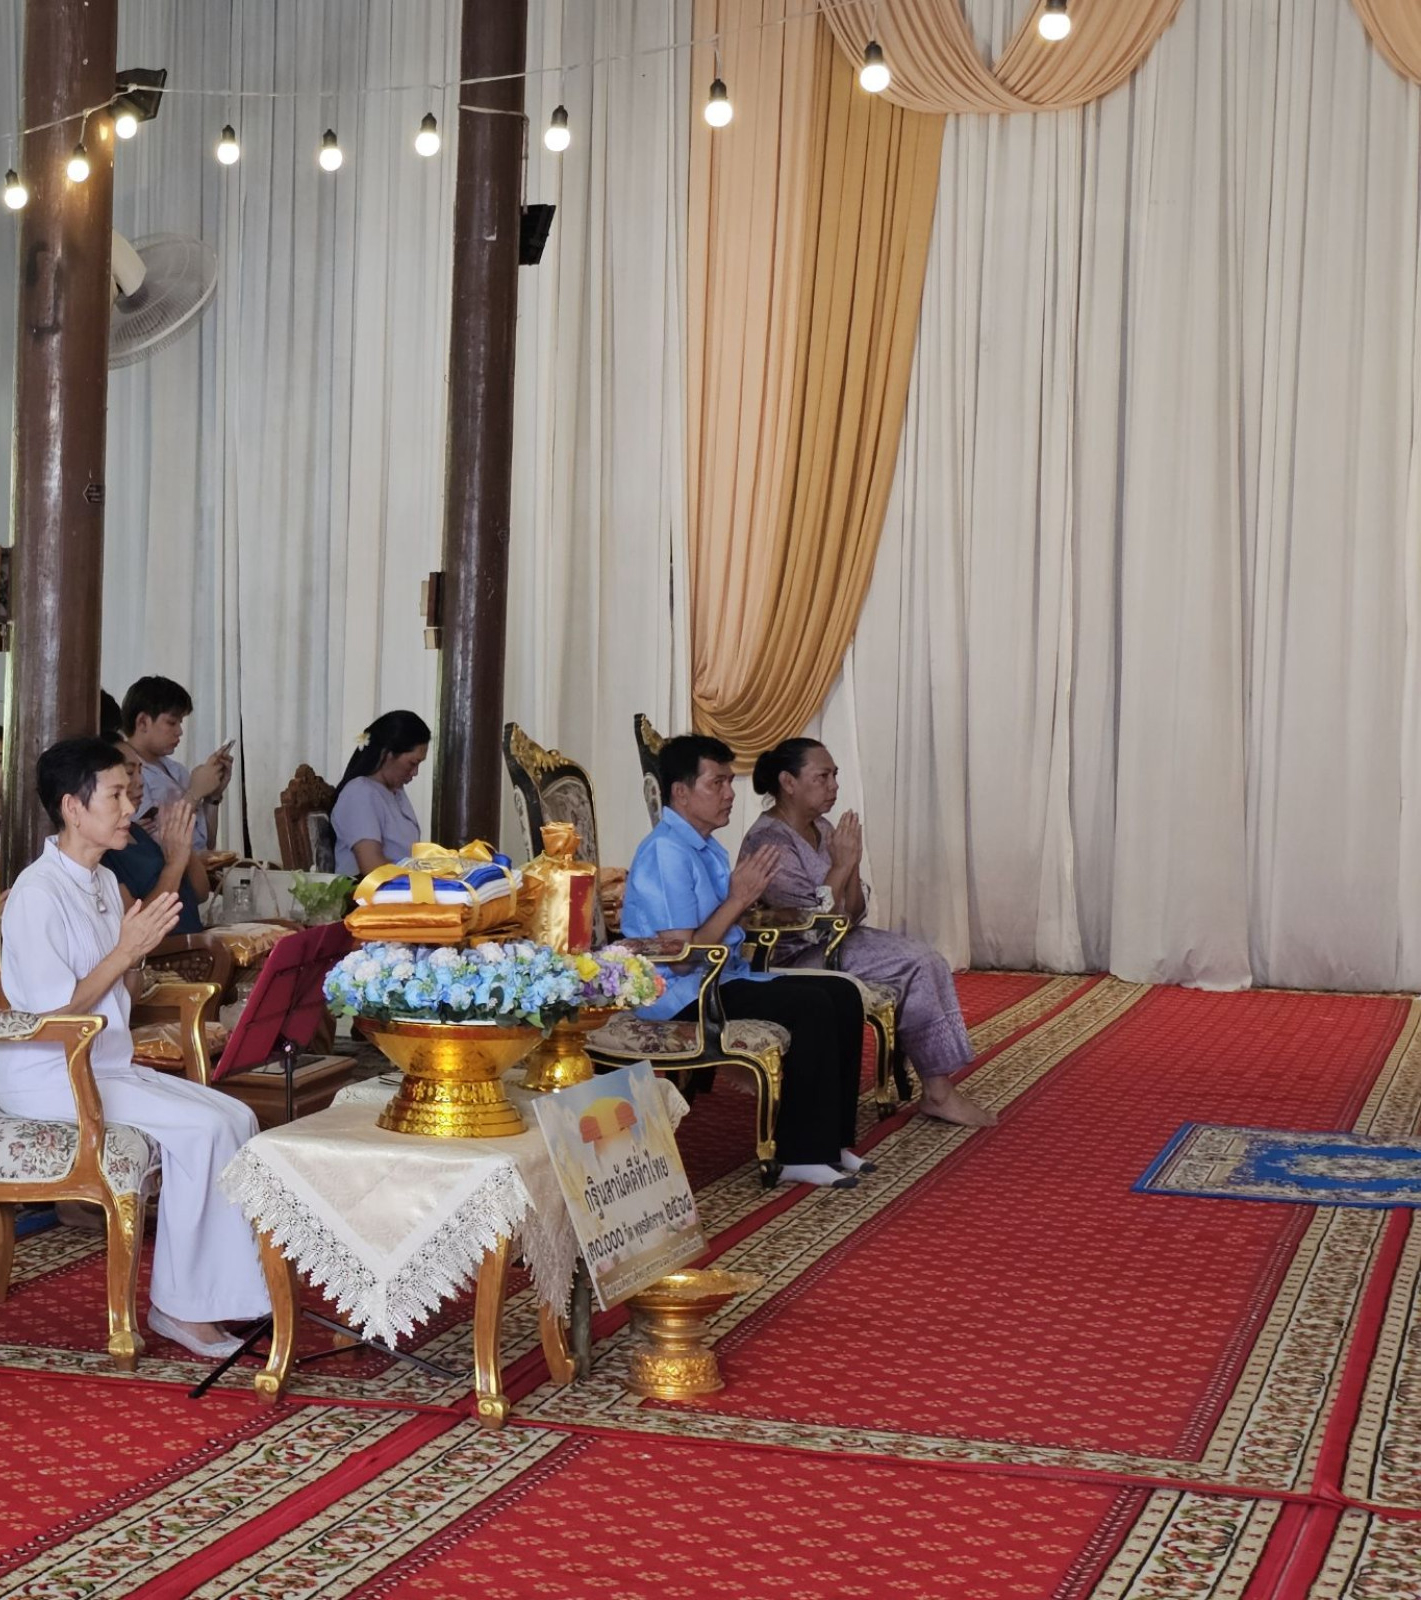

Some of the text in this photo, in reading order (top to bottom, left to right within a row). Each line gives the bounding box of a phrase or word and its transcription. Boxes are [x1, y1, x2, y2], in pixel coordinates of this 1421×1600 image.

[584, 1146, 669, 1220] กฐินสามัคคีทั่วไทย
